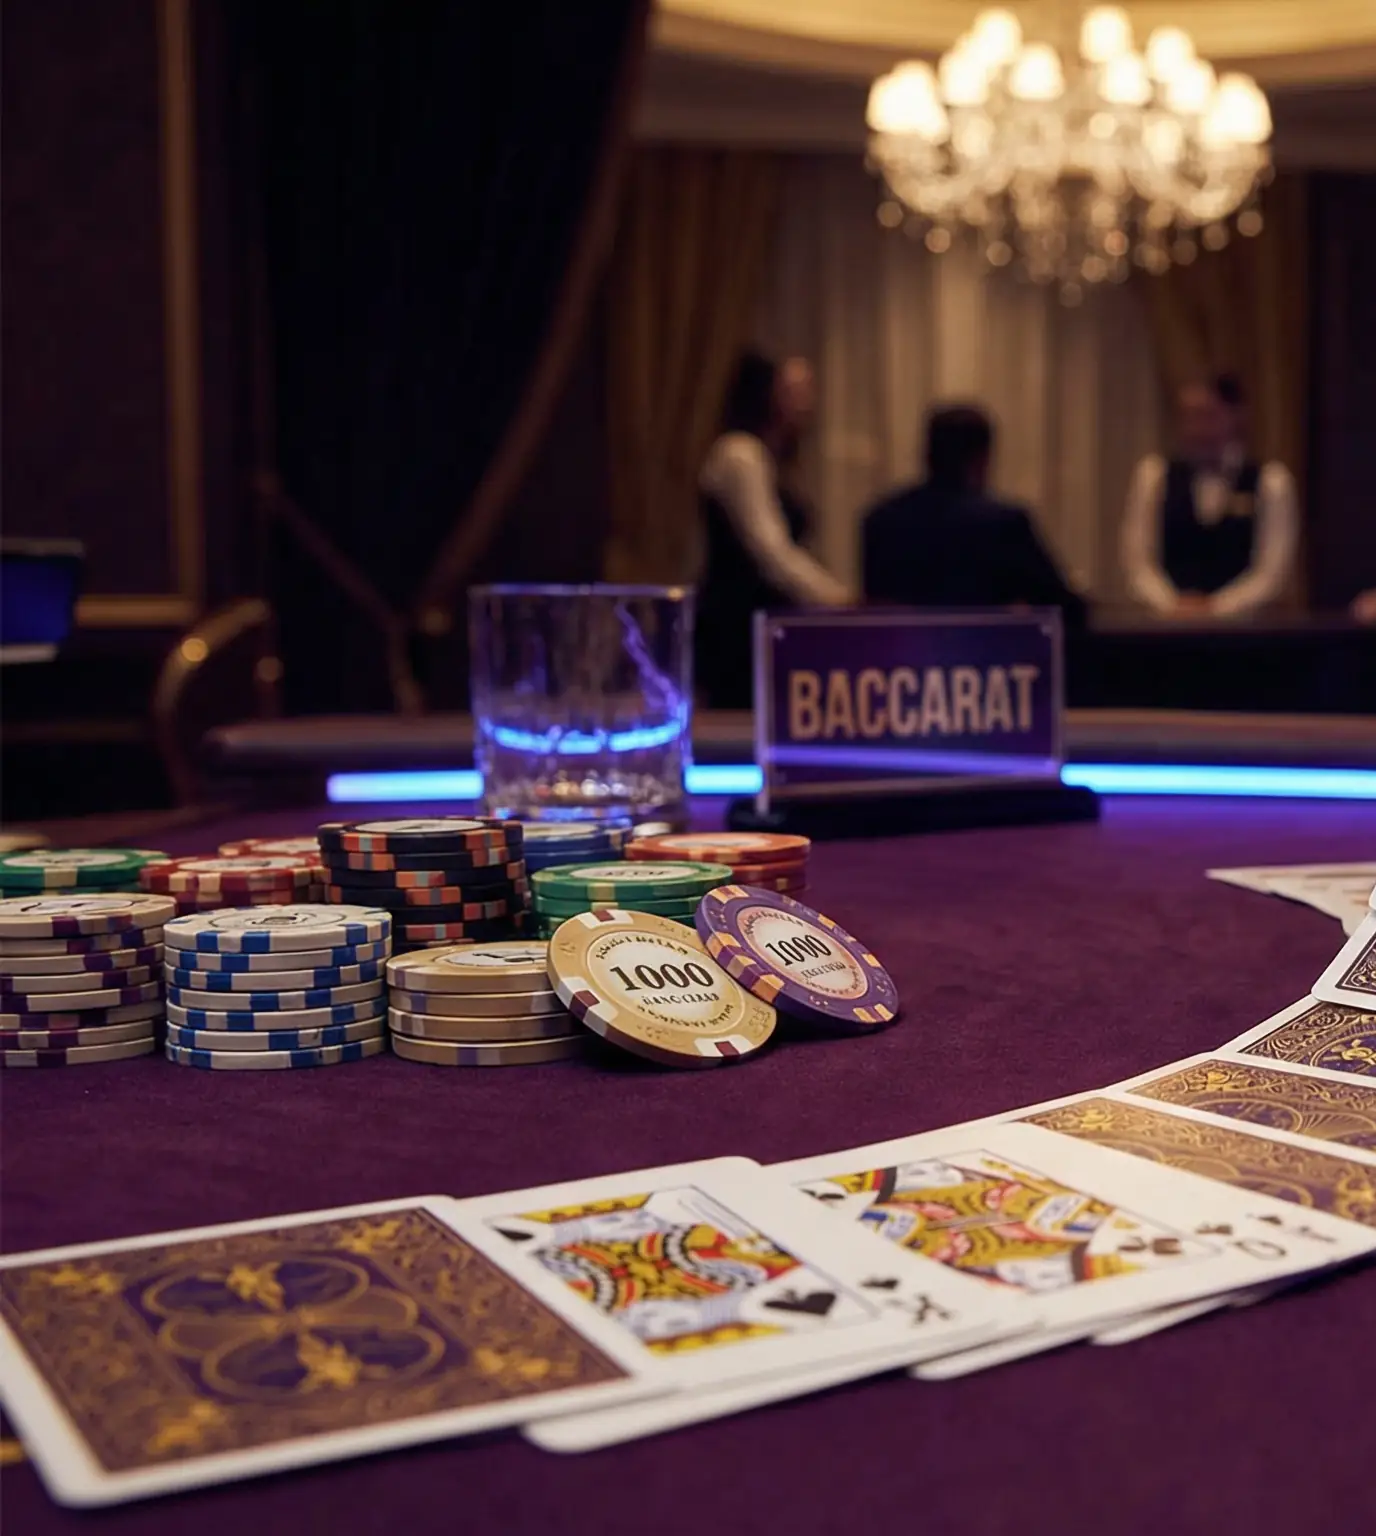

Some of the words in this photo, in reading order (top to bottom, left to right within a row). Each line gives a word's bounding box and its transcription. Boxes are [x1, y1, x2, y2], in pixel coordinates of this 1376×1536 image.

[790, 667, 1038, 738] BACCARAT
[765, 934, 832, 967] 1000
[609, 962, 715, 991] 1000
